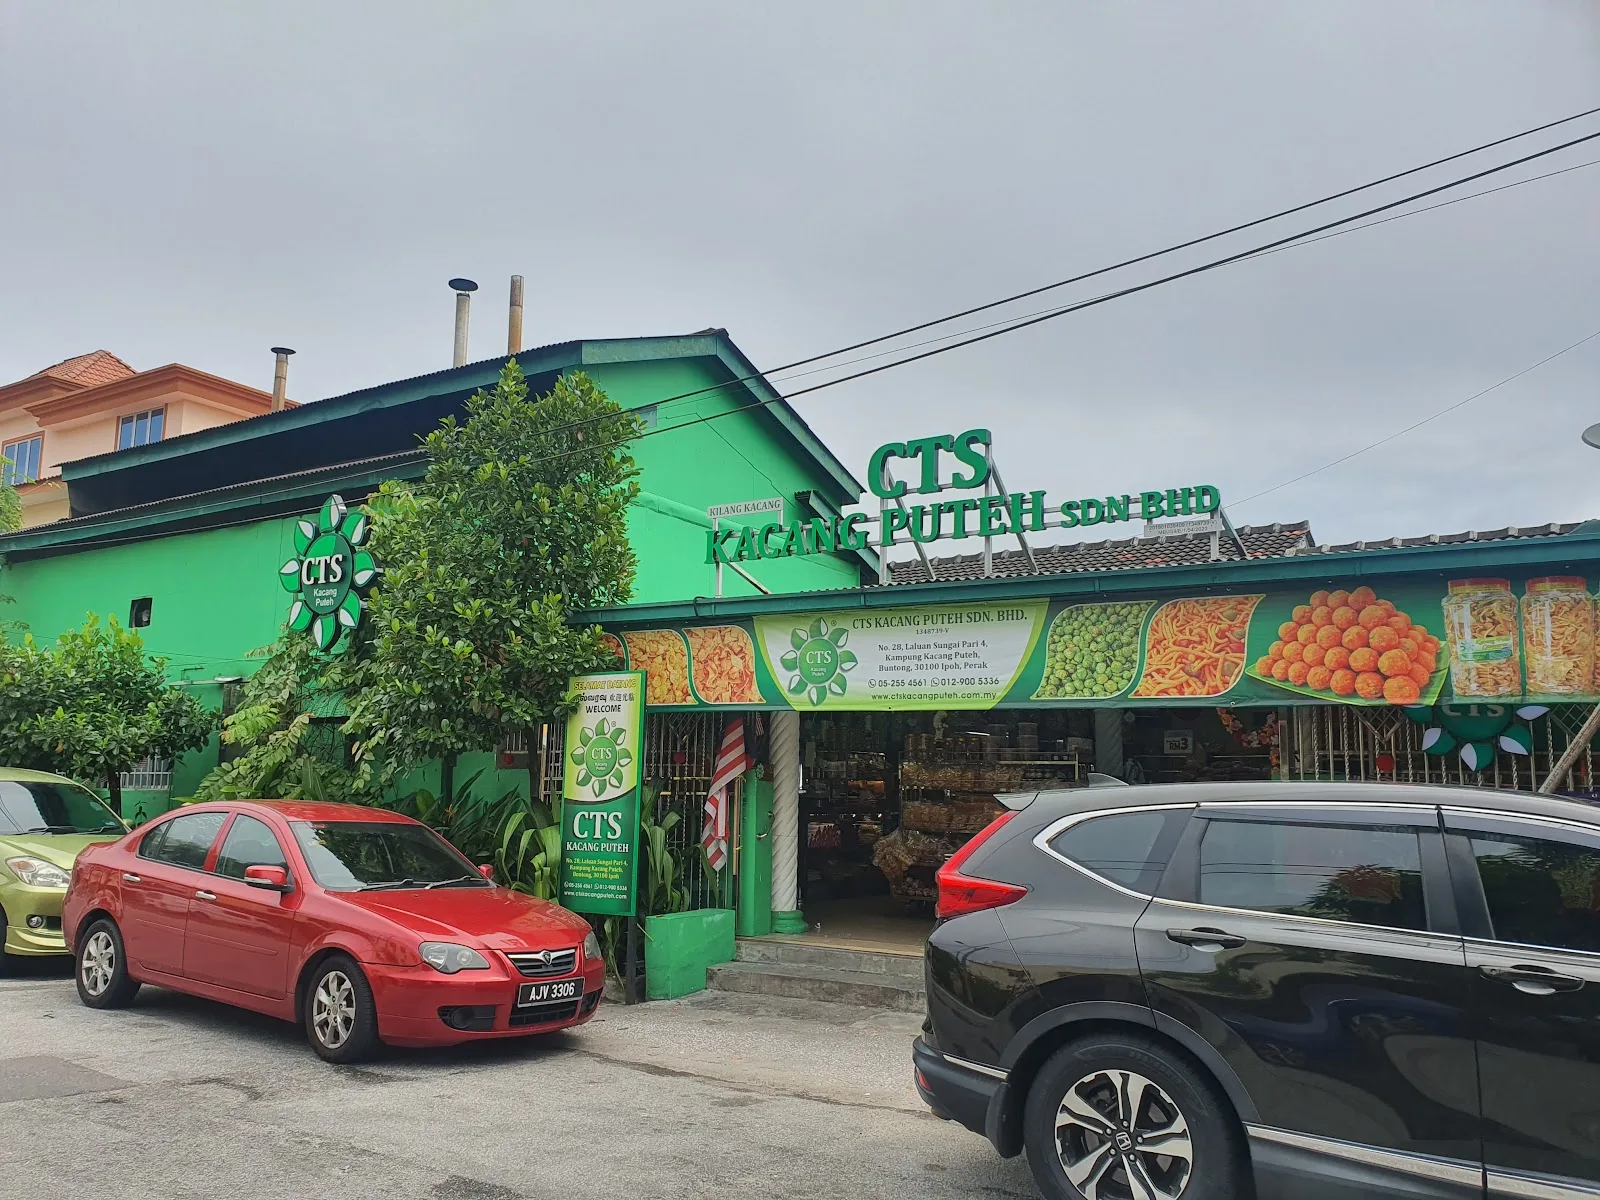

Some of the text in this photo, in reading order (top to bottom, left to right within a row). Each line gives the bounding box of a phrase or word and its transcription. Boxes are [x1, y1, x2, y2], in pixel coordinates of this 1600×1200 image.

[868, 428, 992, 499] CTS
[710, 500, 780, 516] KILANG KACANG
[704, 484, 1222, 565] KACANG PUTEH SDN BHD
[302, 554, 342, 585] CTS
[314, 588, 337, 598] Kacang
[316, 598, 334, 607] Puteh
[853, 610, 1027, 629] CTS KACANG PUTEH SDN. BHD.
[933, 641, 960, 650] Sungai
[980, 640, 988, 648] 4,
[806, 651, 831, 664] CTS
[885, 654, 922, 662] Kampung
[954, 651, 980, 659] Puteh,
[879, 664, 912, 672] Buntong,
[941, 662, 961, 671] Ipoh,
[941, 678, 975, 686] 012-900
[978, 677, 999, 685] 5336
[872, 692, 996, 700] www.ctskacangputeh.com.my
[586, 705, 621, 713] WELCOME
[592, 748, 612, 759] CTS
[573, 811, 622, 839] CTS
[566, 842, 629, 852] KACANG PUTEH
[530, 982, 575, 1000] AJV 3306
